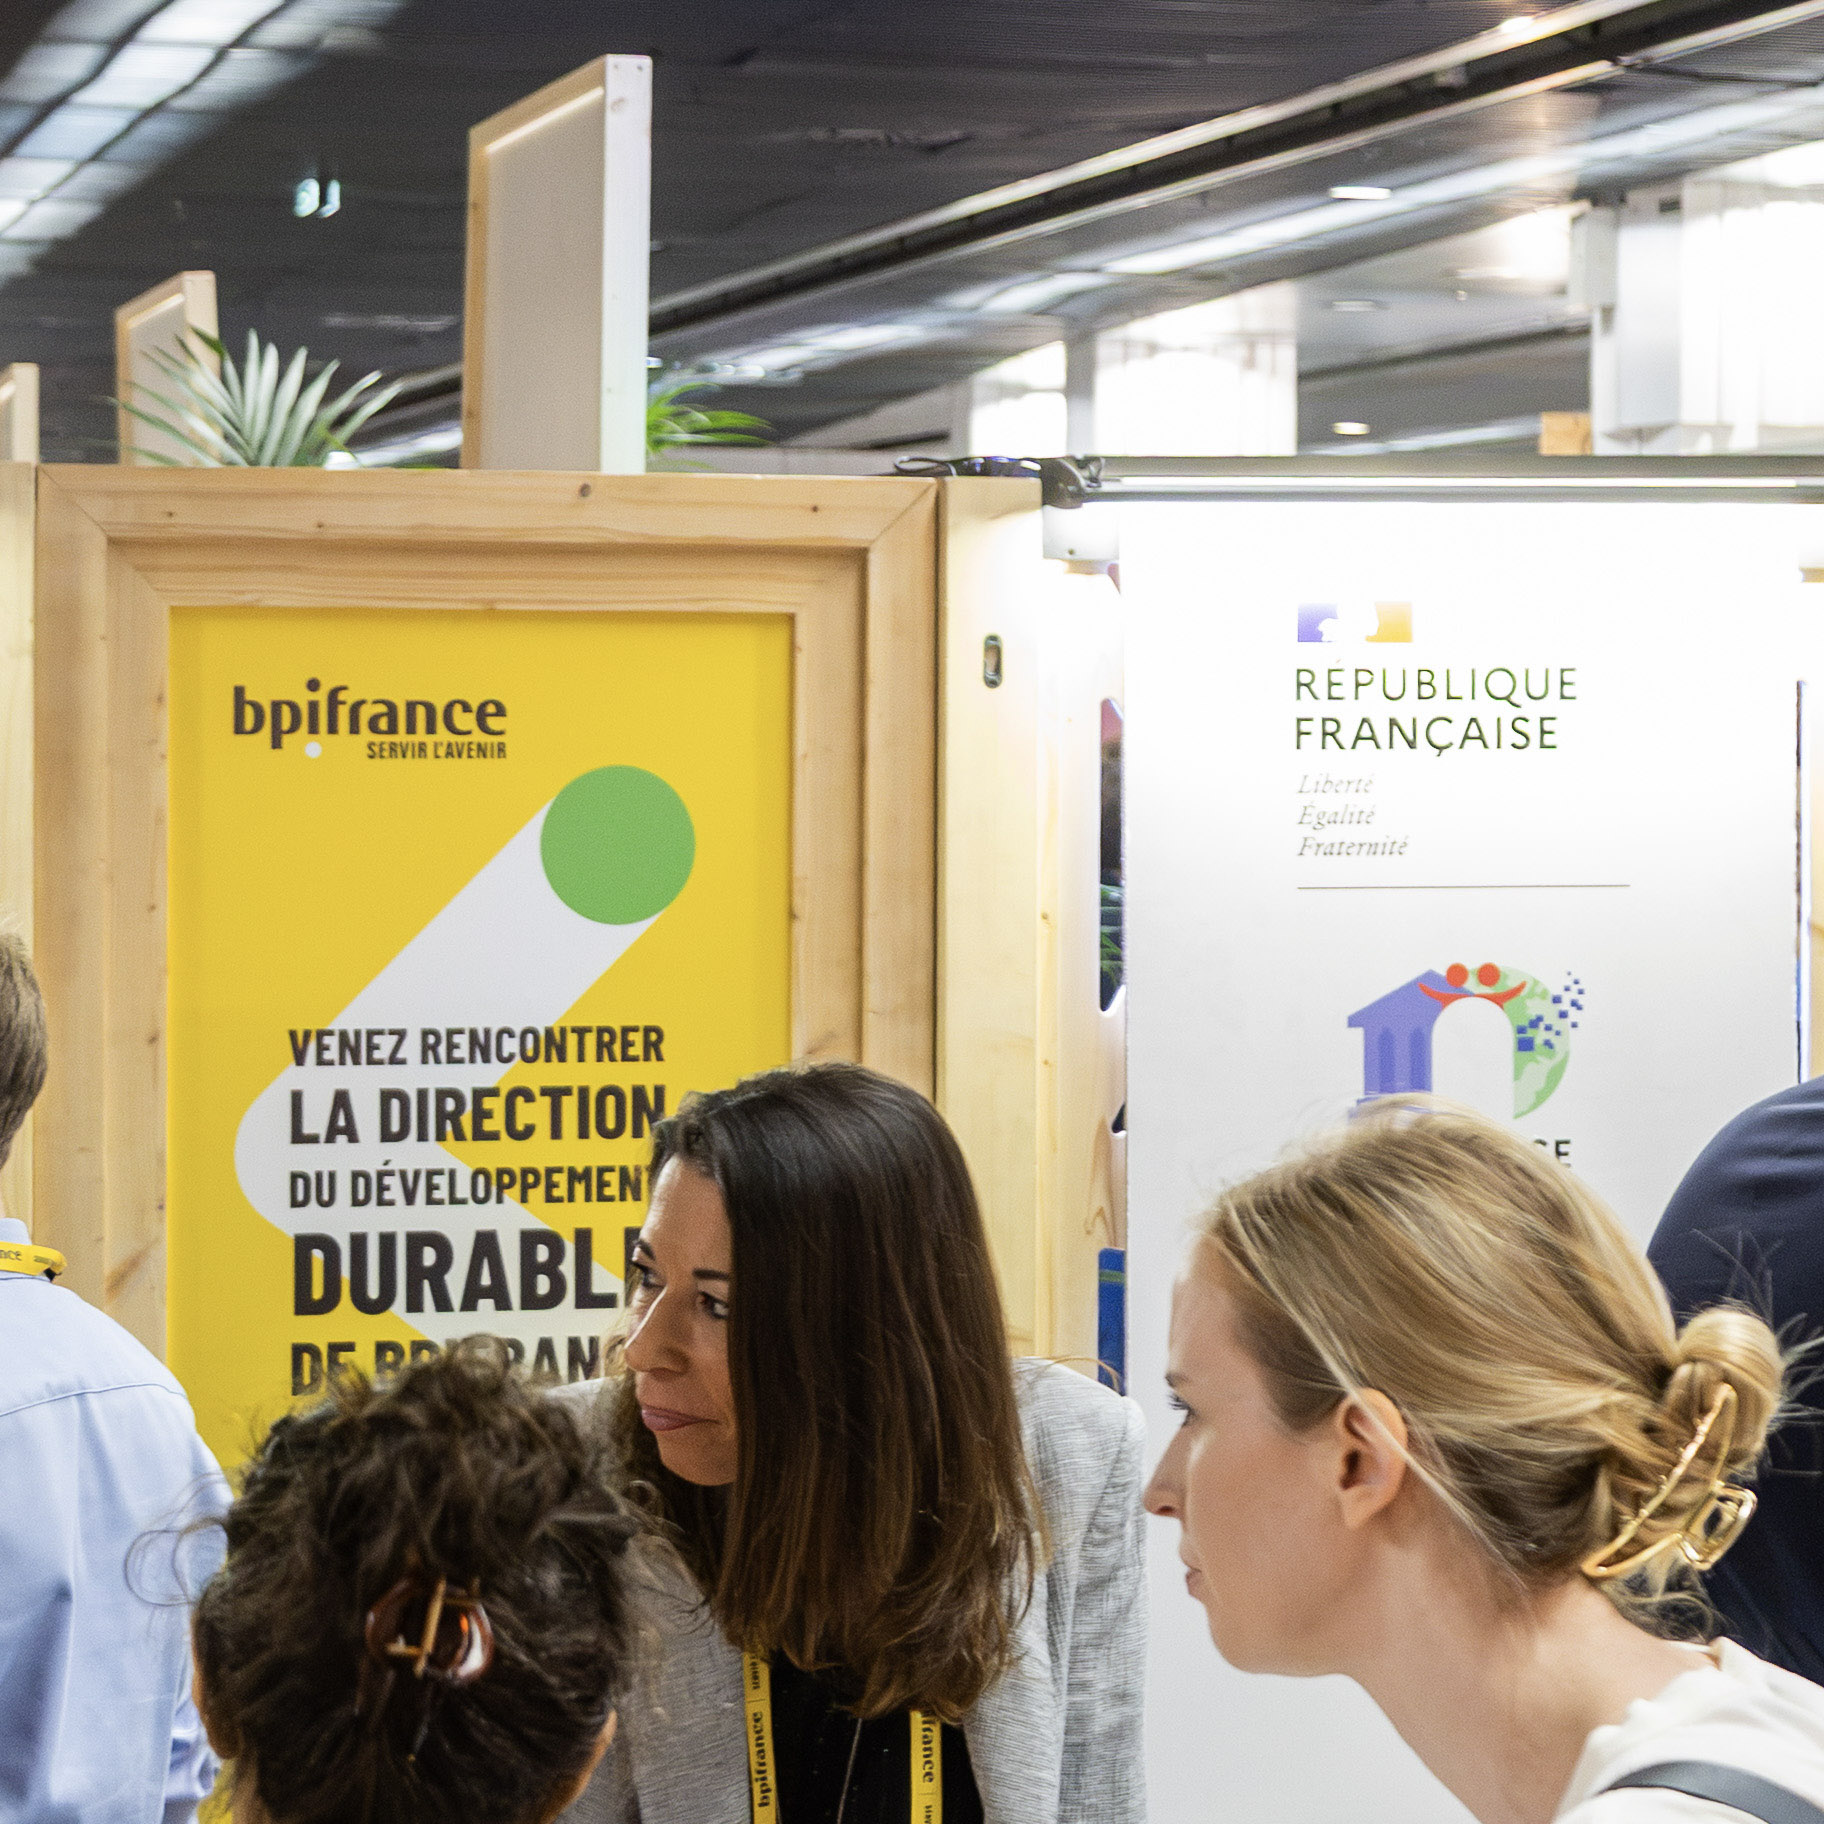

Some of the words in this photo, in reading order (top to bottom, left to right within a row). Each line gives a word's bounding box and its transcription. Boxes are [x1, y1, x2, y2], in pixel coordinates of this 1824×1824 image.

[1295, 658, 1578, 708] RÉPUBLIQUE
[233, 678, 507, 750] bpifrance
[367, 741, 428, 760] SERVIR
[433, 741, 507, 760] L'AVENIR
[1295, 716, 1559, 757] FRANÇAISE
[1297, 773, 1375, 794] Liberté
[1297, 801, 1376, 831] Égalité
[1297, 835, 1410, 857] Fraternité
[289, 1028, 408, 1066] VENEZ
[421, 1025, 665, 1064] RENCONTRER
[290, 1088, 360, 1144] LA
[379, 1084, 666, 1142] DIRECTION
[289, 1169, 337, 1208] DU
[351, 1159, 651, 1207] DÉVELOPPEMEN
